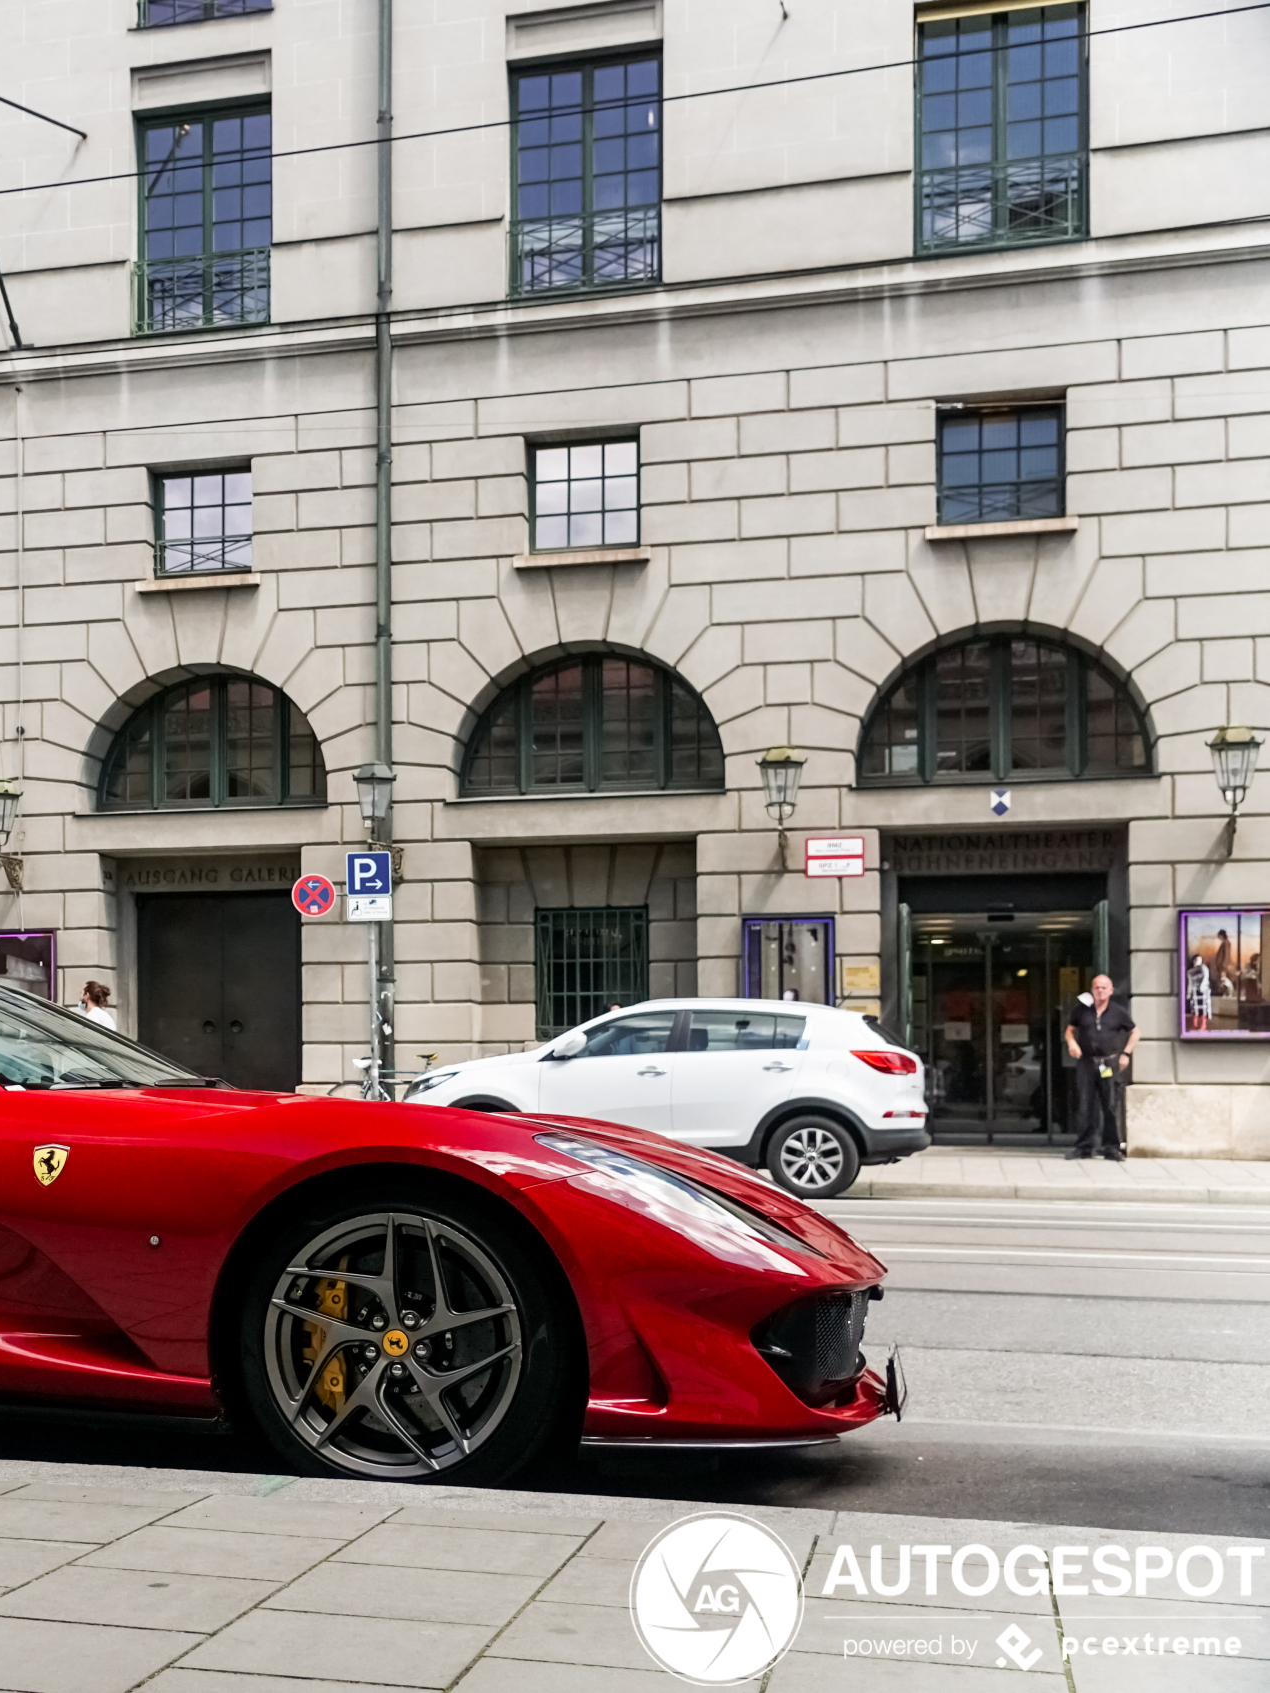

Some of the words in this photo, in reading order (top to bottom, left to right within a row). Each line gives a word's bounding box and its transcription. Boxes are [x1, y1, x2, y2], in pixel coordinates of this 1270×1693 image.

[893, 830, 1113, 853] NATIONALTHEATER
[126, 868, 218, 886] AUSGANG
[354, 858, 377, 890] P
